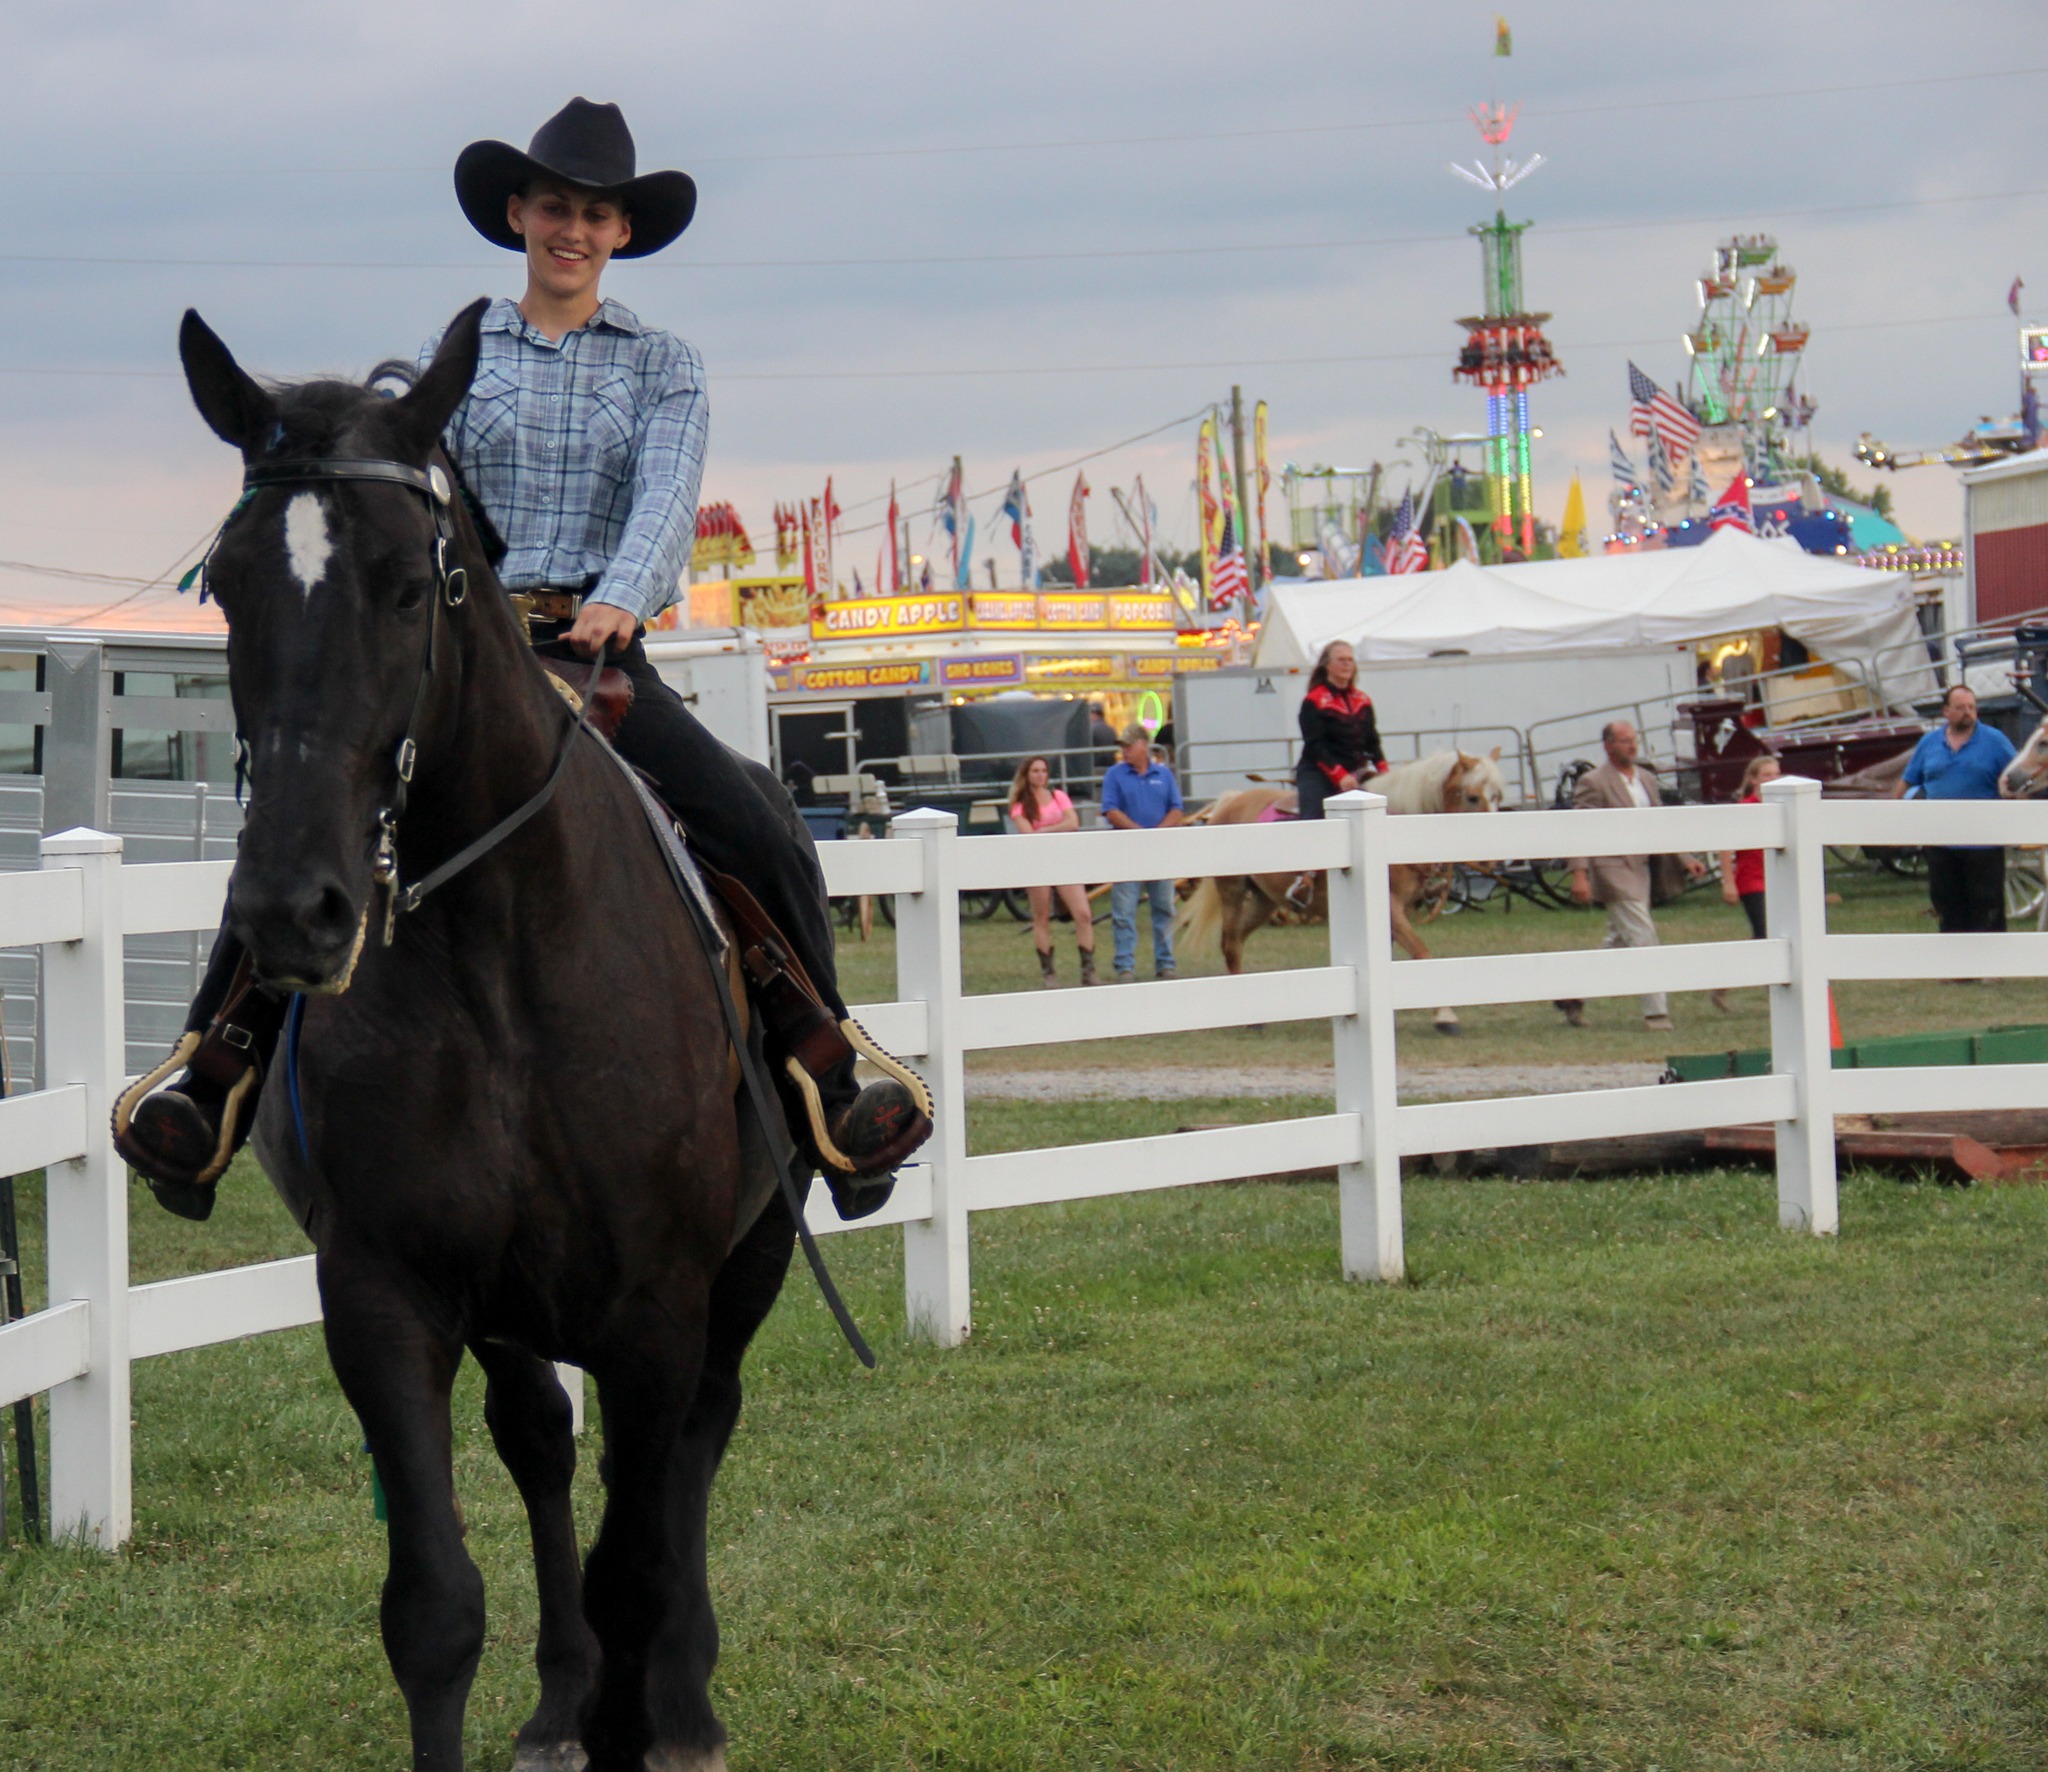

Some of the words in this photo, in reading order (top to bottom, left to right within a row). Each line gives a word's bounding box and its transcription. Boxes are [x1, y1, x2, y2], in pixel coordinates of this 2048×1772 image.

[825, 606, 891, 631] CANDY
[896, 601, 960, 625] APPLE
[1047, 601, 1079, 621] COTTON
[1115, 602, 1173, 621] POPCORN
[1135, 657, 1175, 675] CANDY
[1176, 656, 1219, 673] APPLES
[806, 668, 868, 689] COTTON
[869, 663, 922, 685] CANDY
